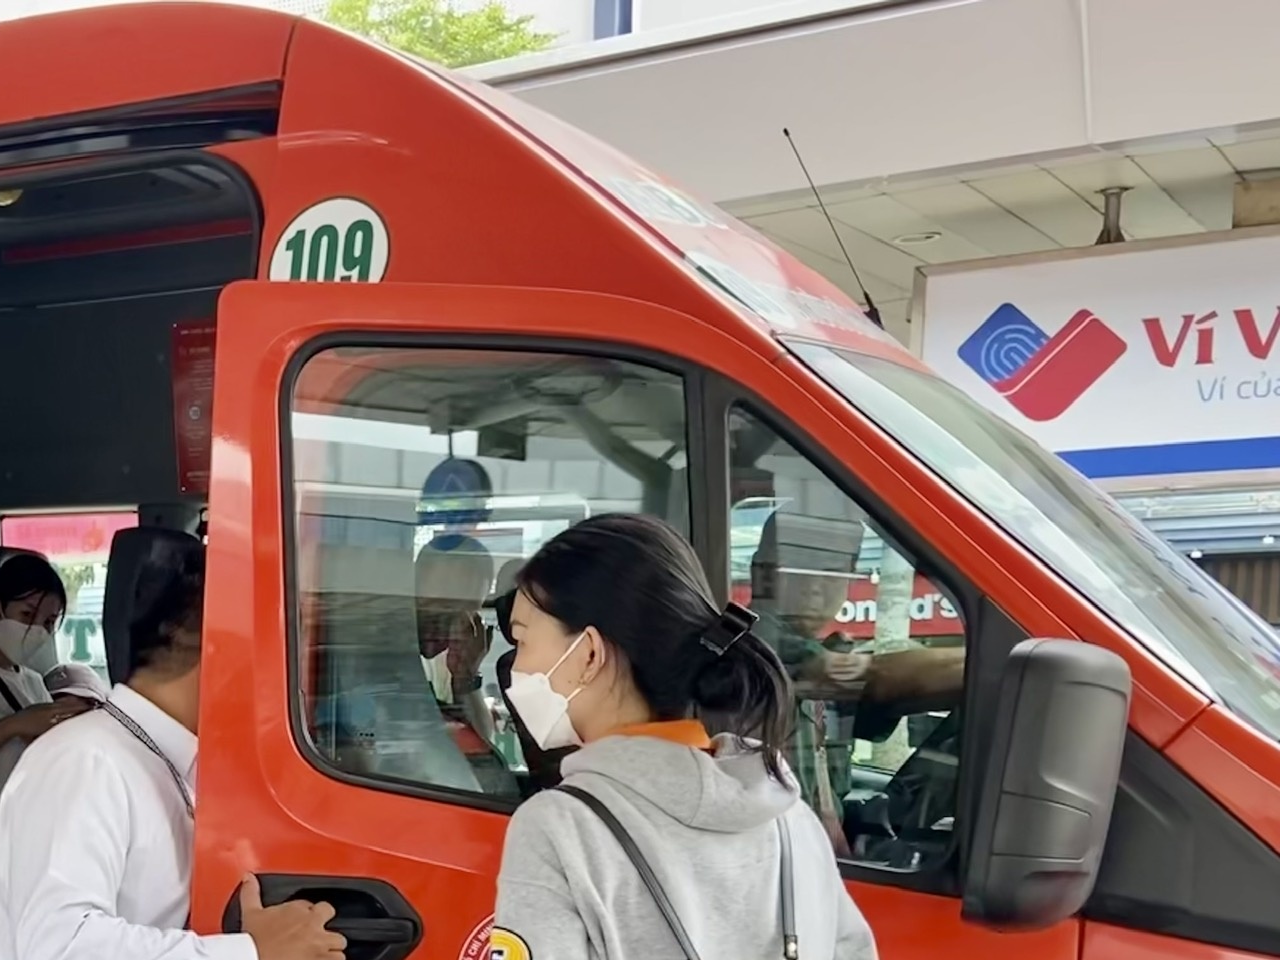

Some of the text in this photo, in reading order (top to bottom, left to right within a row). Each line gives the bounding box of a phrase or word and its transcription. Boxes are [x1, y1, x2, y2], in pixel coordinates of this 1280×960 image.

[285, 219, 374, 282] 109
[1142, 310, 1218, 367] Ví
[1197, 376, 1227, 401] Ví
